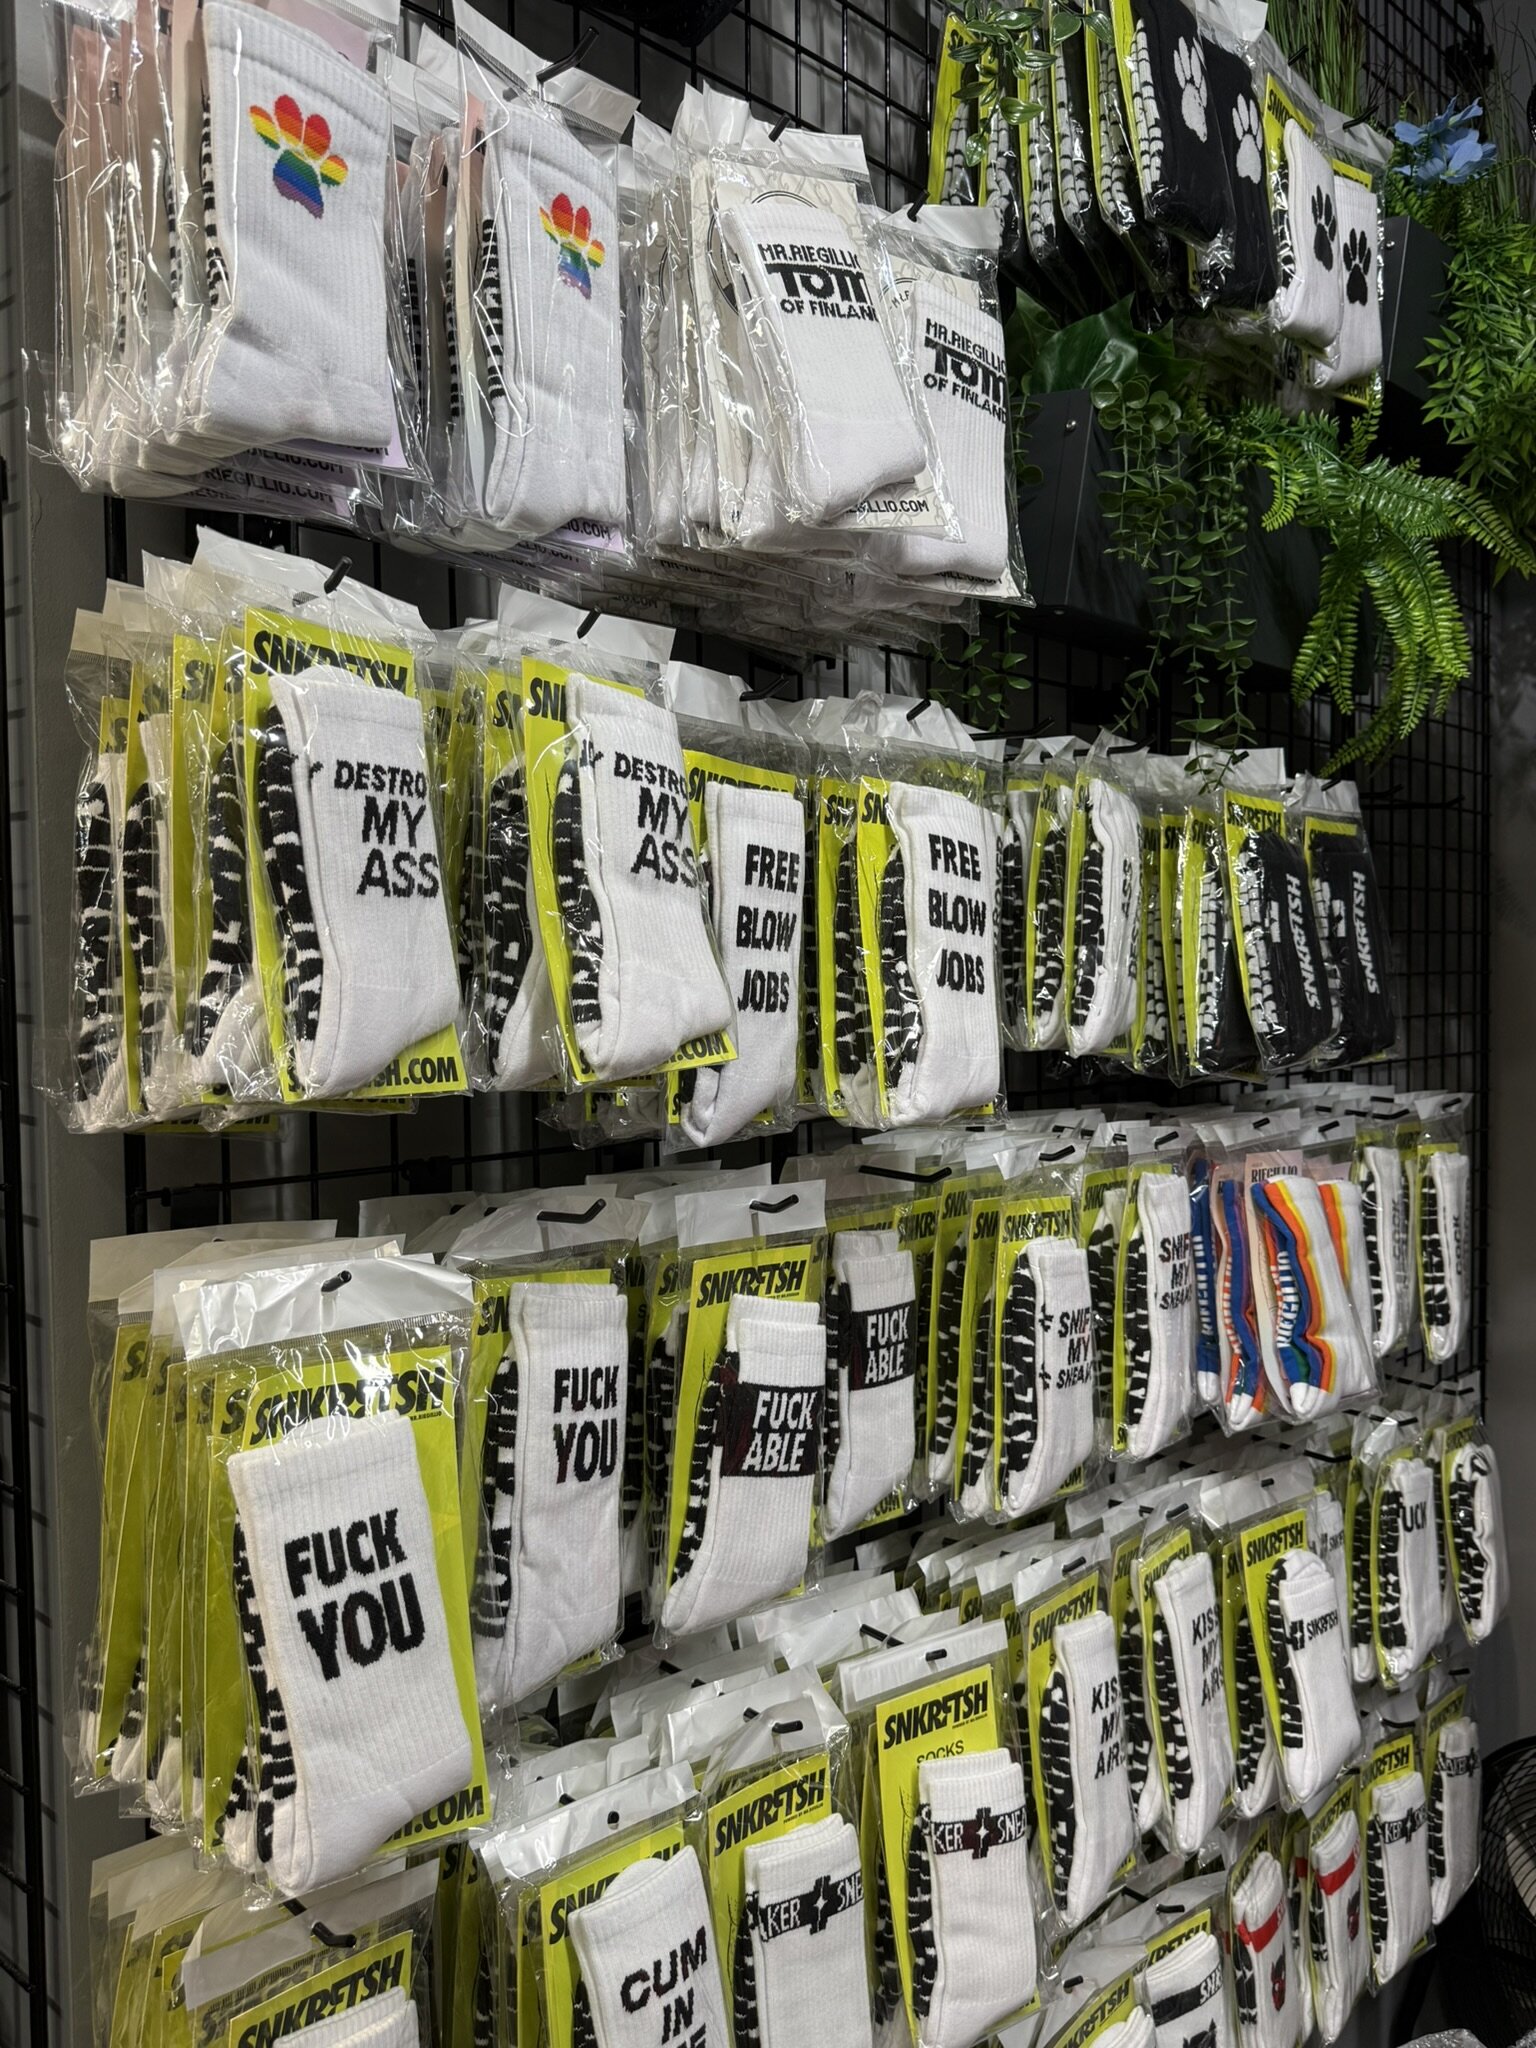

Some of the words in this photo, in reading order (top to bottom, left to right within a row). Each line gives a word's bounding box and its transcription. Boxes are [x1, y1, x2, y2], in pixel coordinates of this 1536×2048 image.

[780, 299, 804, 315] OF
[923, 372, 948, 392] OF
[362, 796, 427, 848] MY
[638, 785, 688, 841] MY
[356, 848, 440, 899] ASS
[630, 834, 701, 890] ASS
[745, 843, 800, 893] FREE
[928, 833, 982, 882] FREE
[736, 905, 797, 952] BLOW
[928, 888, 987, 937] BLOW
[737, 969, 790, 1013] JOBS
[936, 948, 985, 995] JOBS
[1171, 1259, 1190, 1290] MY
[866, 1305, 911, 1348] FUCK
[1067, 1334, 1090, 1365] MY
[865, 1342, 905, 1384] ABLE
[553, 1365, 619, 1414] FUCK
[753, 1390, 818, 1431] FUCK
[553, 1418, 618, 1484] YOU
[741, 1432, 806, 1472] ABLE
[284, 1508, 408, 1599] FUCK
[1246, 1520, 1304, 1568] SNKRFTSH
[297, 1573, 426, 1682] YOU
[884, 1680, 988, 1750] SNKRFTSH
[1091, 1676, 1121, 1714] KIS
[714, 1767, 826, 1857] SNKRFTSH
[620, 1925, 708, 2013] CUM
[662, 1986, 695, 2045] IN
